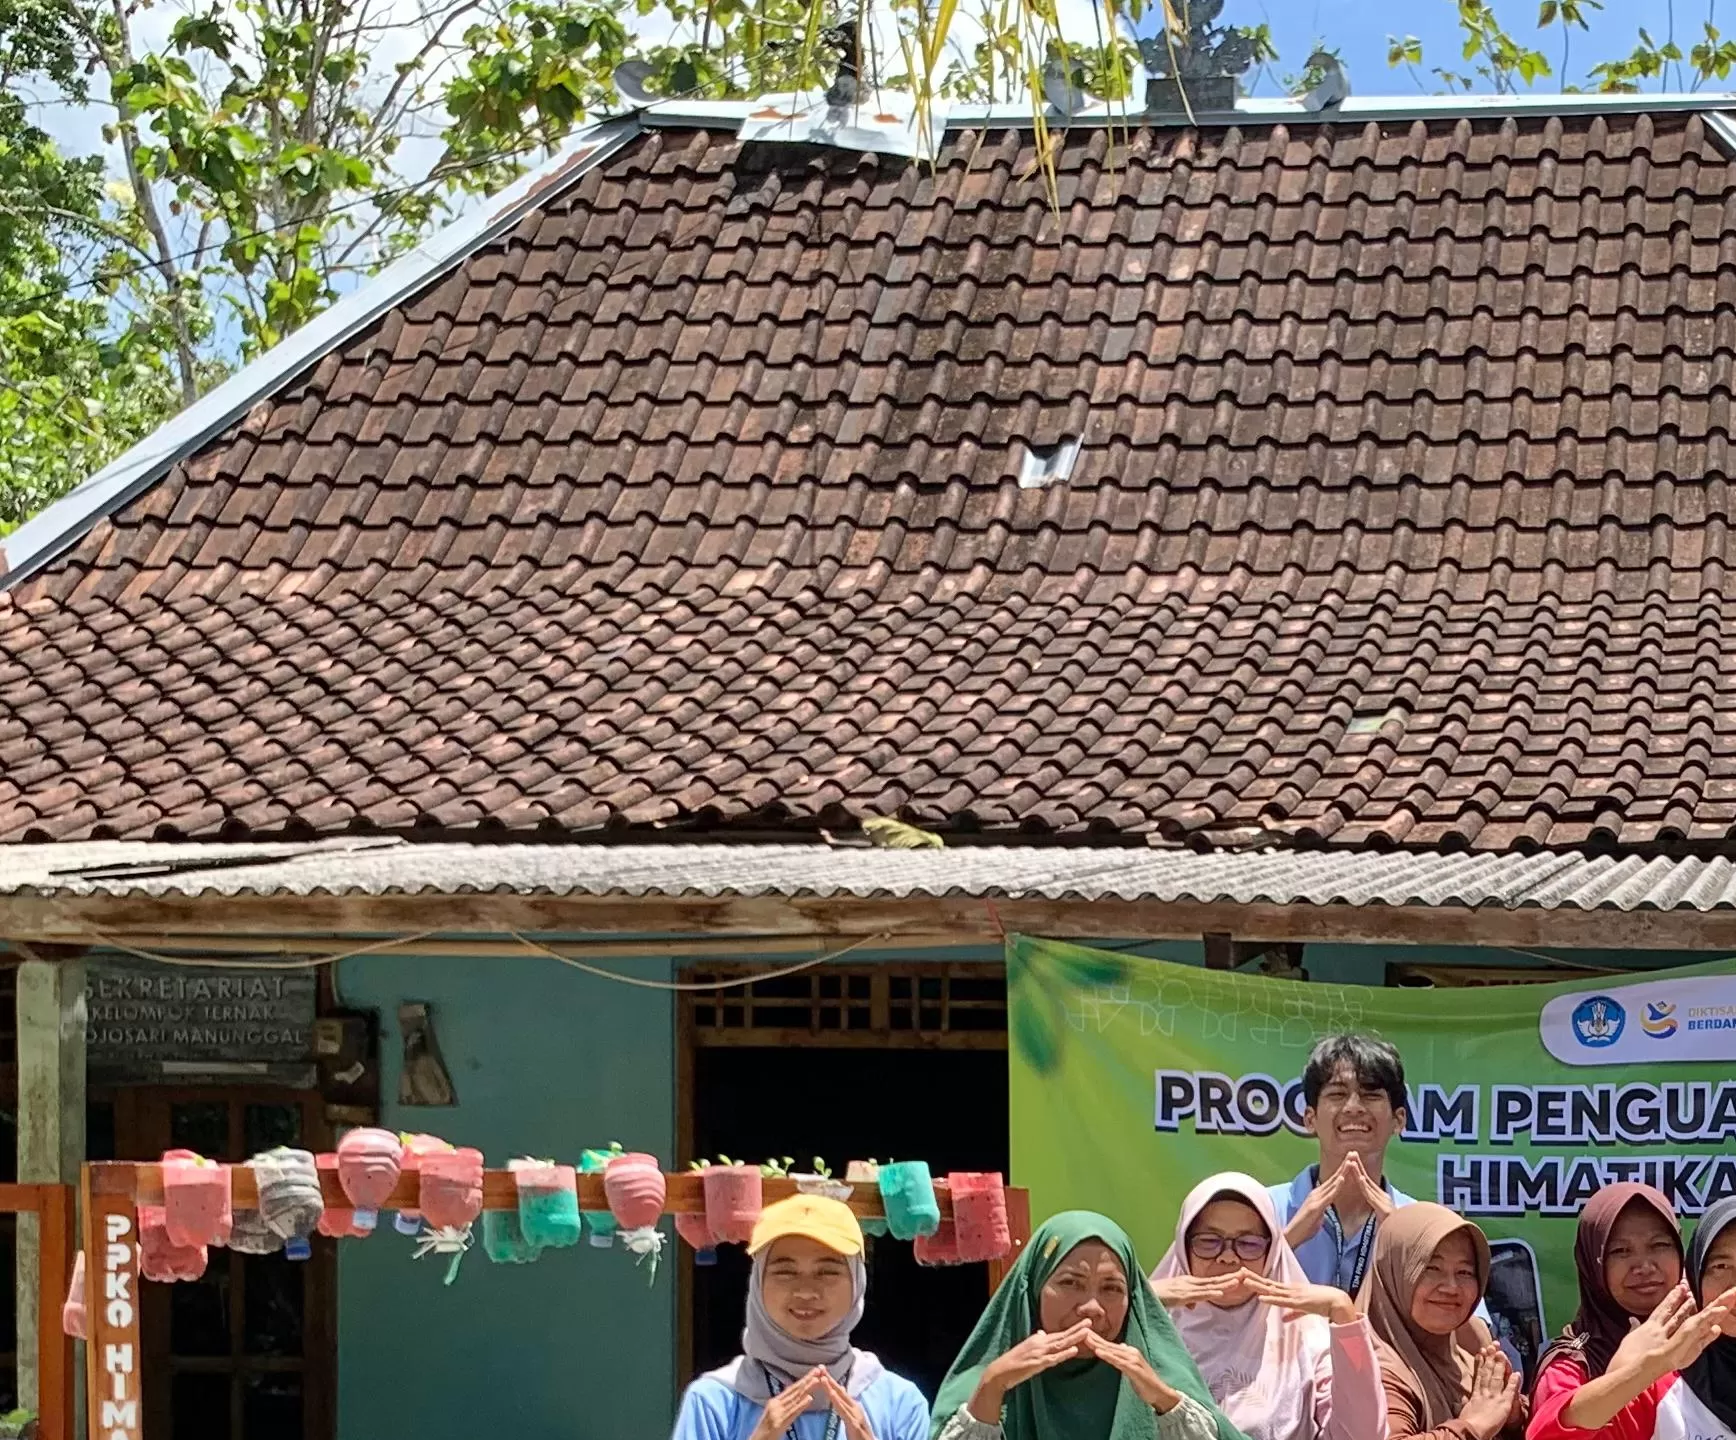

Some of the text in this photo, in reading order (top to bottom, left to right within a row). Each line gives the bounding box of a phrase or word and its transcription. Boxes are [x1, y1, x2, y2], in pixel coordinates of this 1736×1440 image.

[204, 1003, 274, 1020] TERNAK
[84, 1028, 303, 1045] OJOSARI MANUNGGAL
[1154, 1070, 1480, 1144] PROM
[105, 1214, 132, 1329] PPKO
